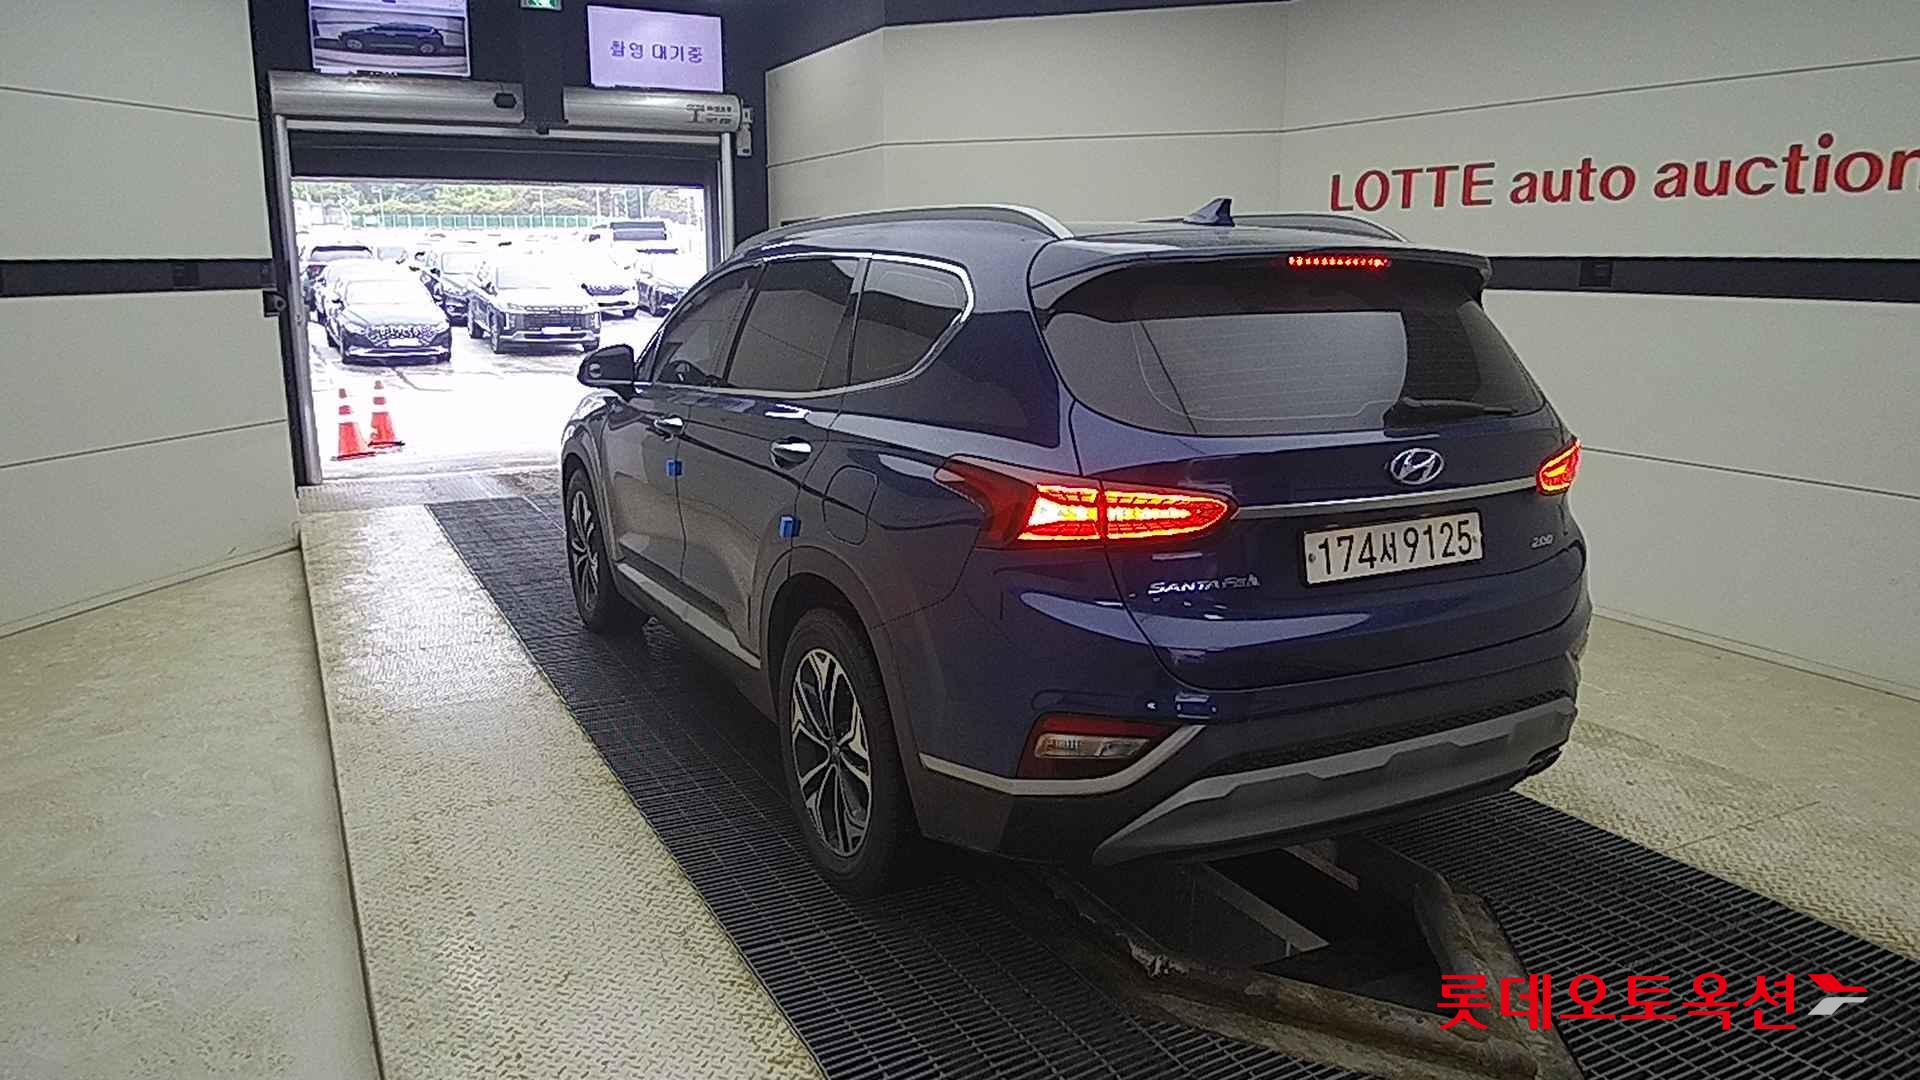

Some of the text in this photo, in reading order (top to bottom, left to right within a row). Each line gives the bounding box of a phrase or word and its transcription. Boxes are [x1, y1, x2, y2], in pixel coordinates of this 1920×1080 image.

[651, 43, 703, 64] 대기중
[1330, 161, 1496, 212] LOTTE
[1509, 157, 1636, 204] auto
[1318, 519, 1473, 575] 174서9125
